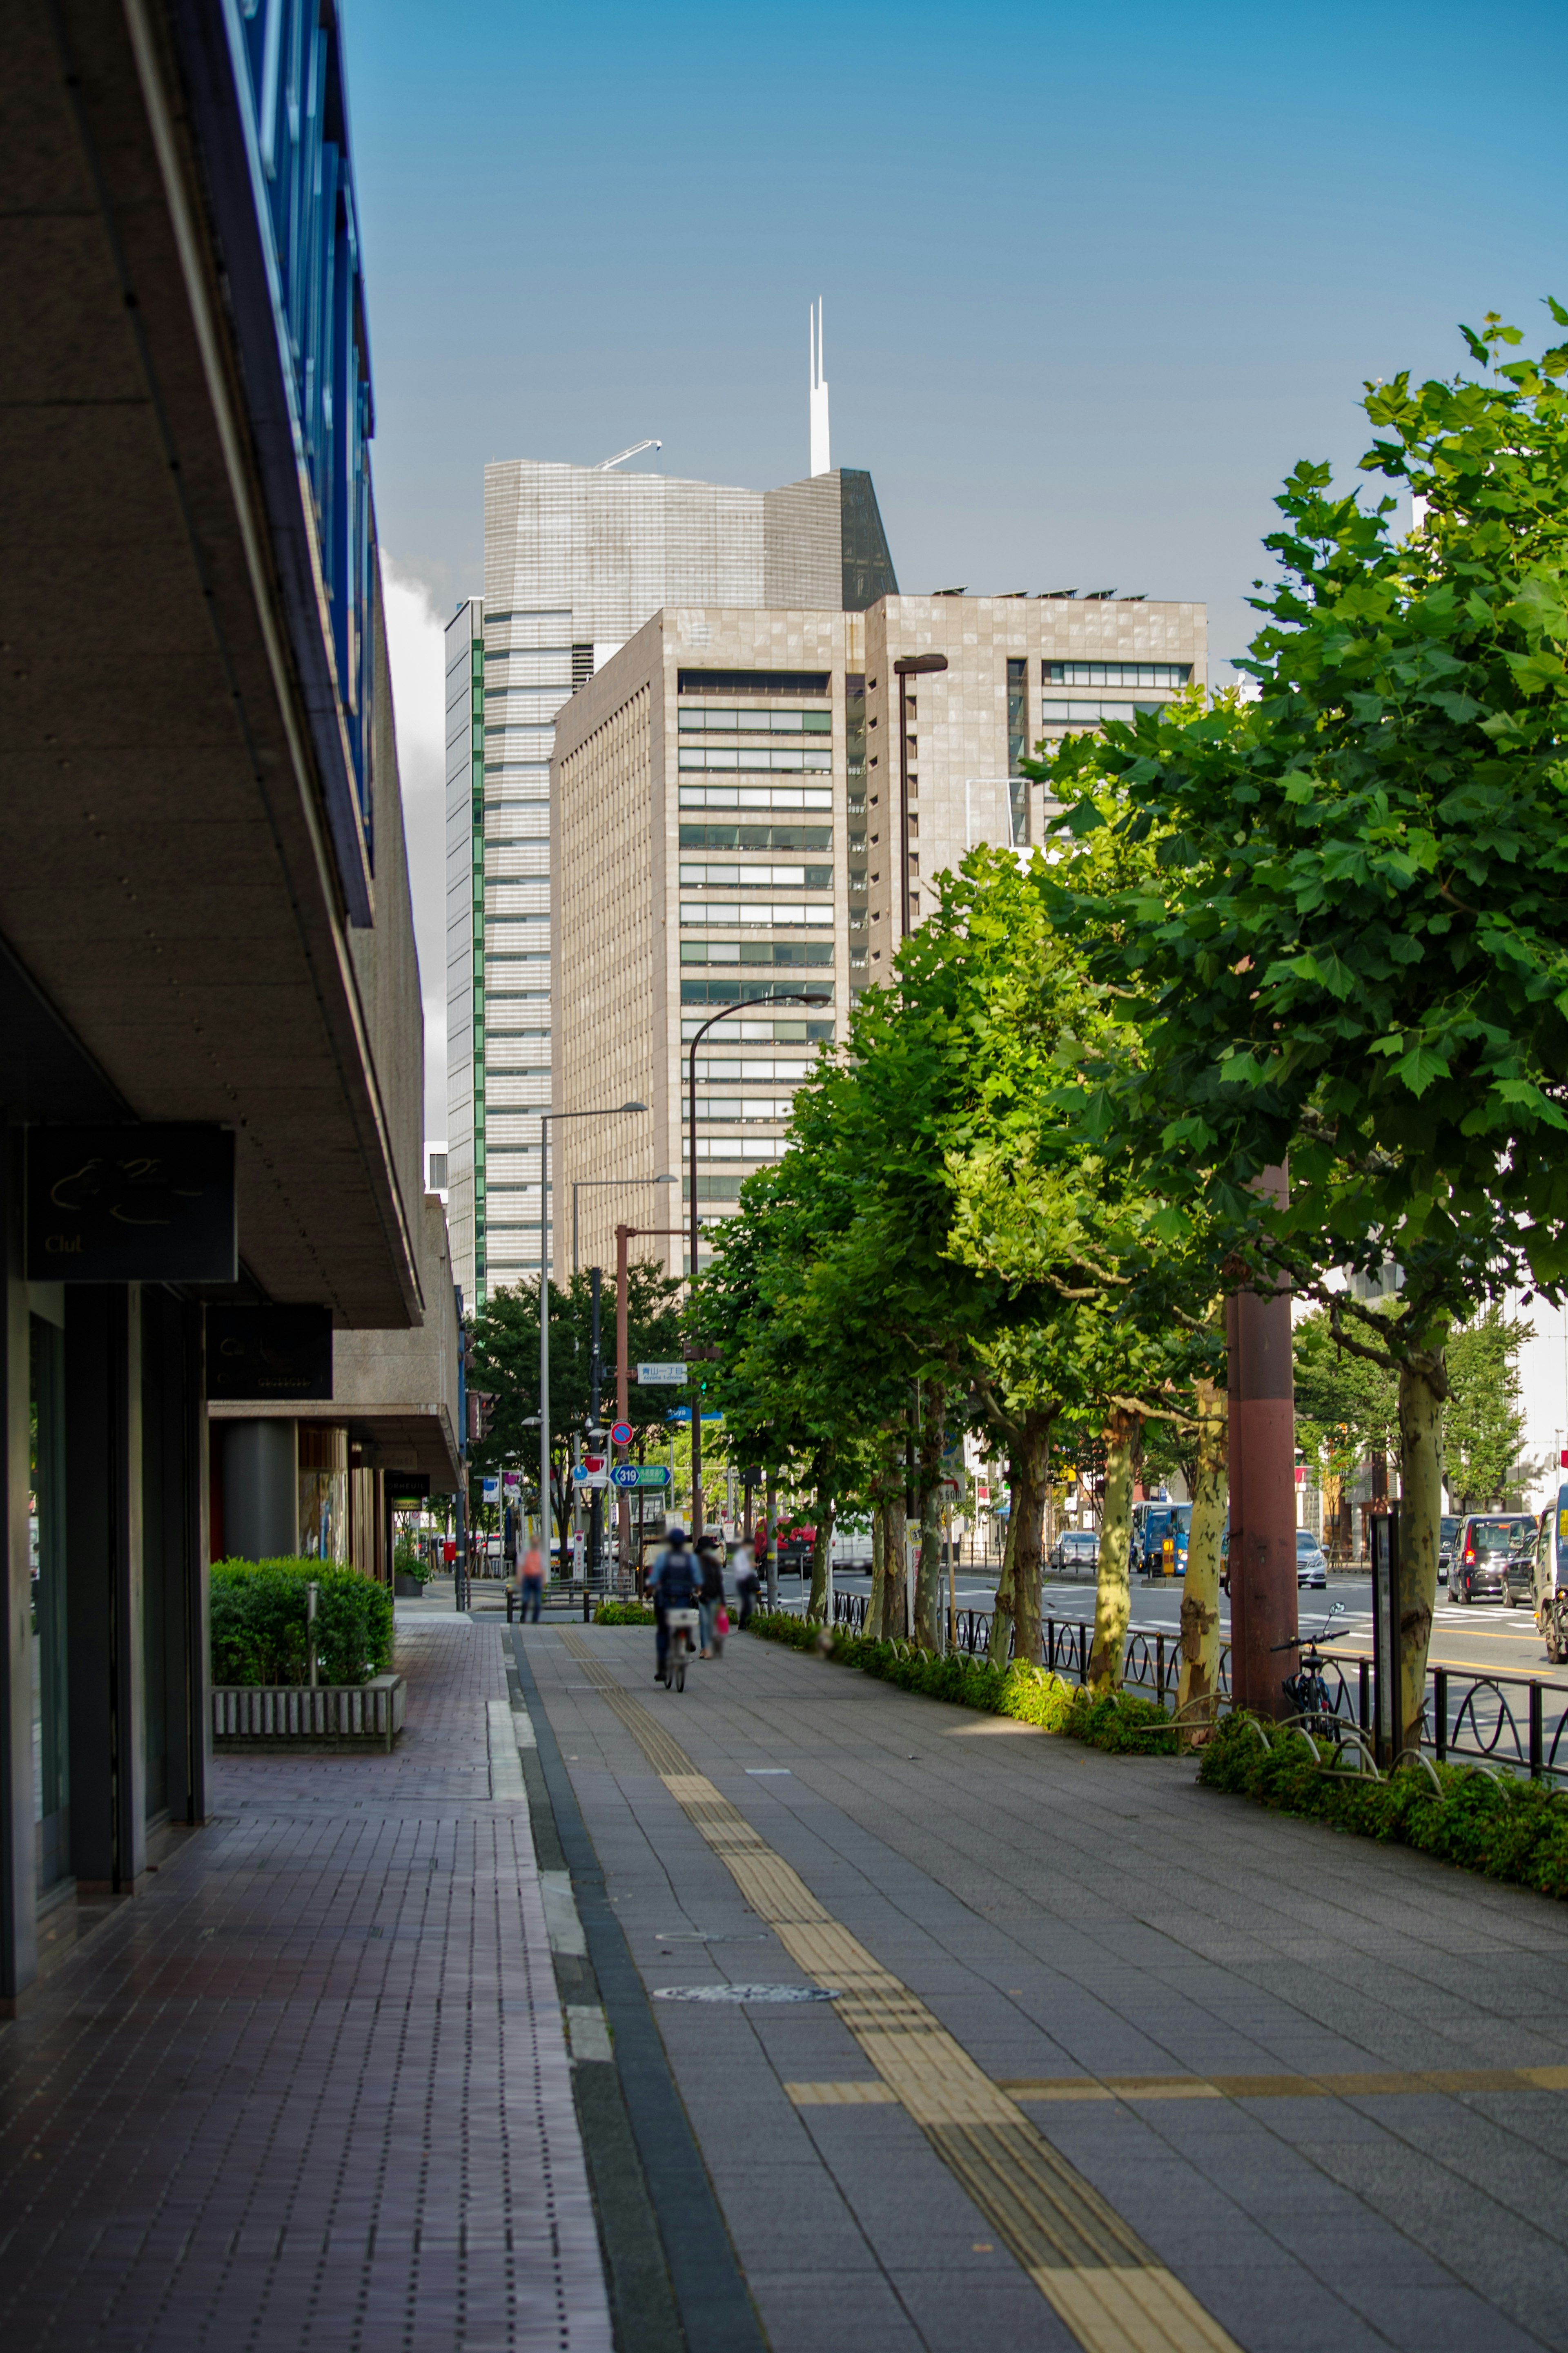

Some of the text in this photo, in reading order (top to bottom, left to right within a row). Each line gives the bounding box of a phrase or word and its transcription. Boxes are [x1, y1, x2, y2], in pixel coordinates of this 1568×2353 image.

[643, 1366, 683, 1376] 青山一丁目
[620, 1470, 637, 1482] 319
